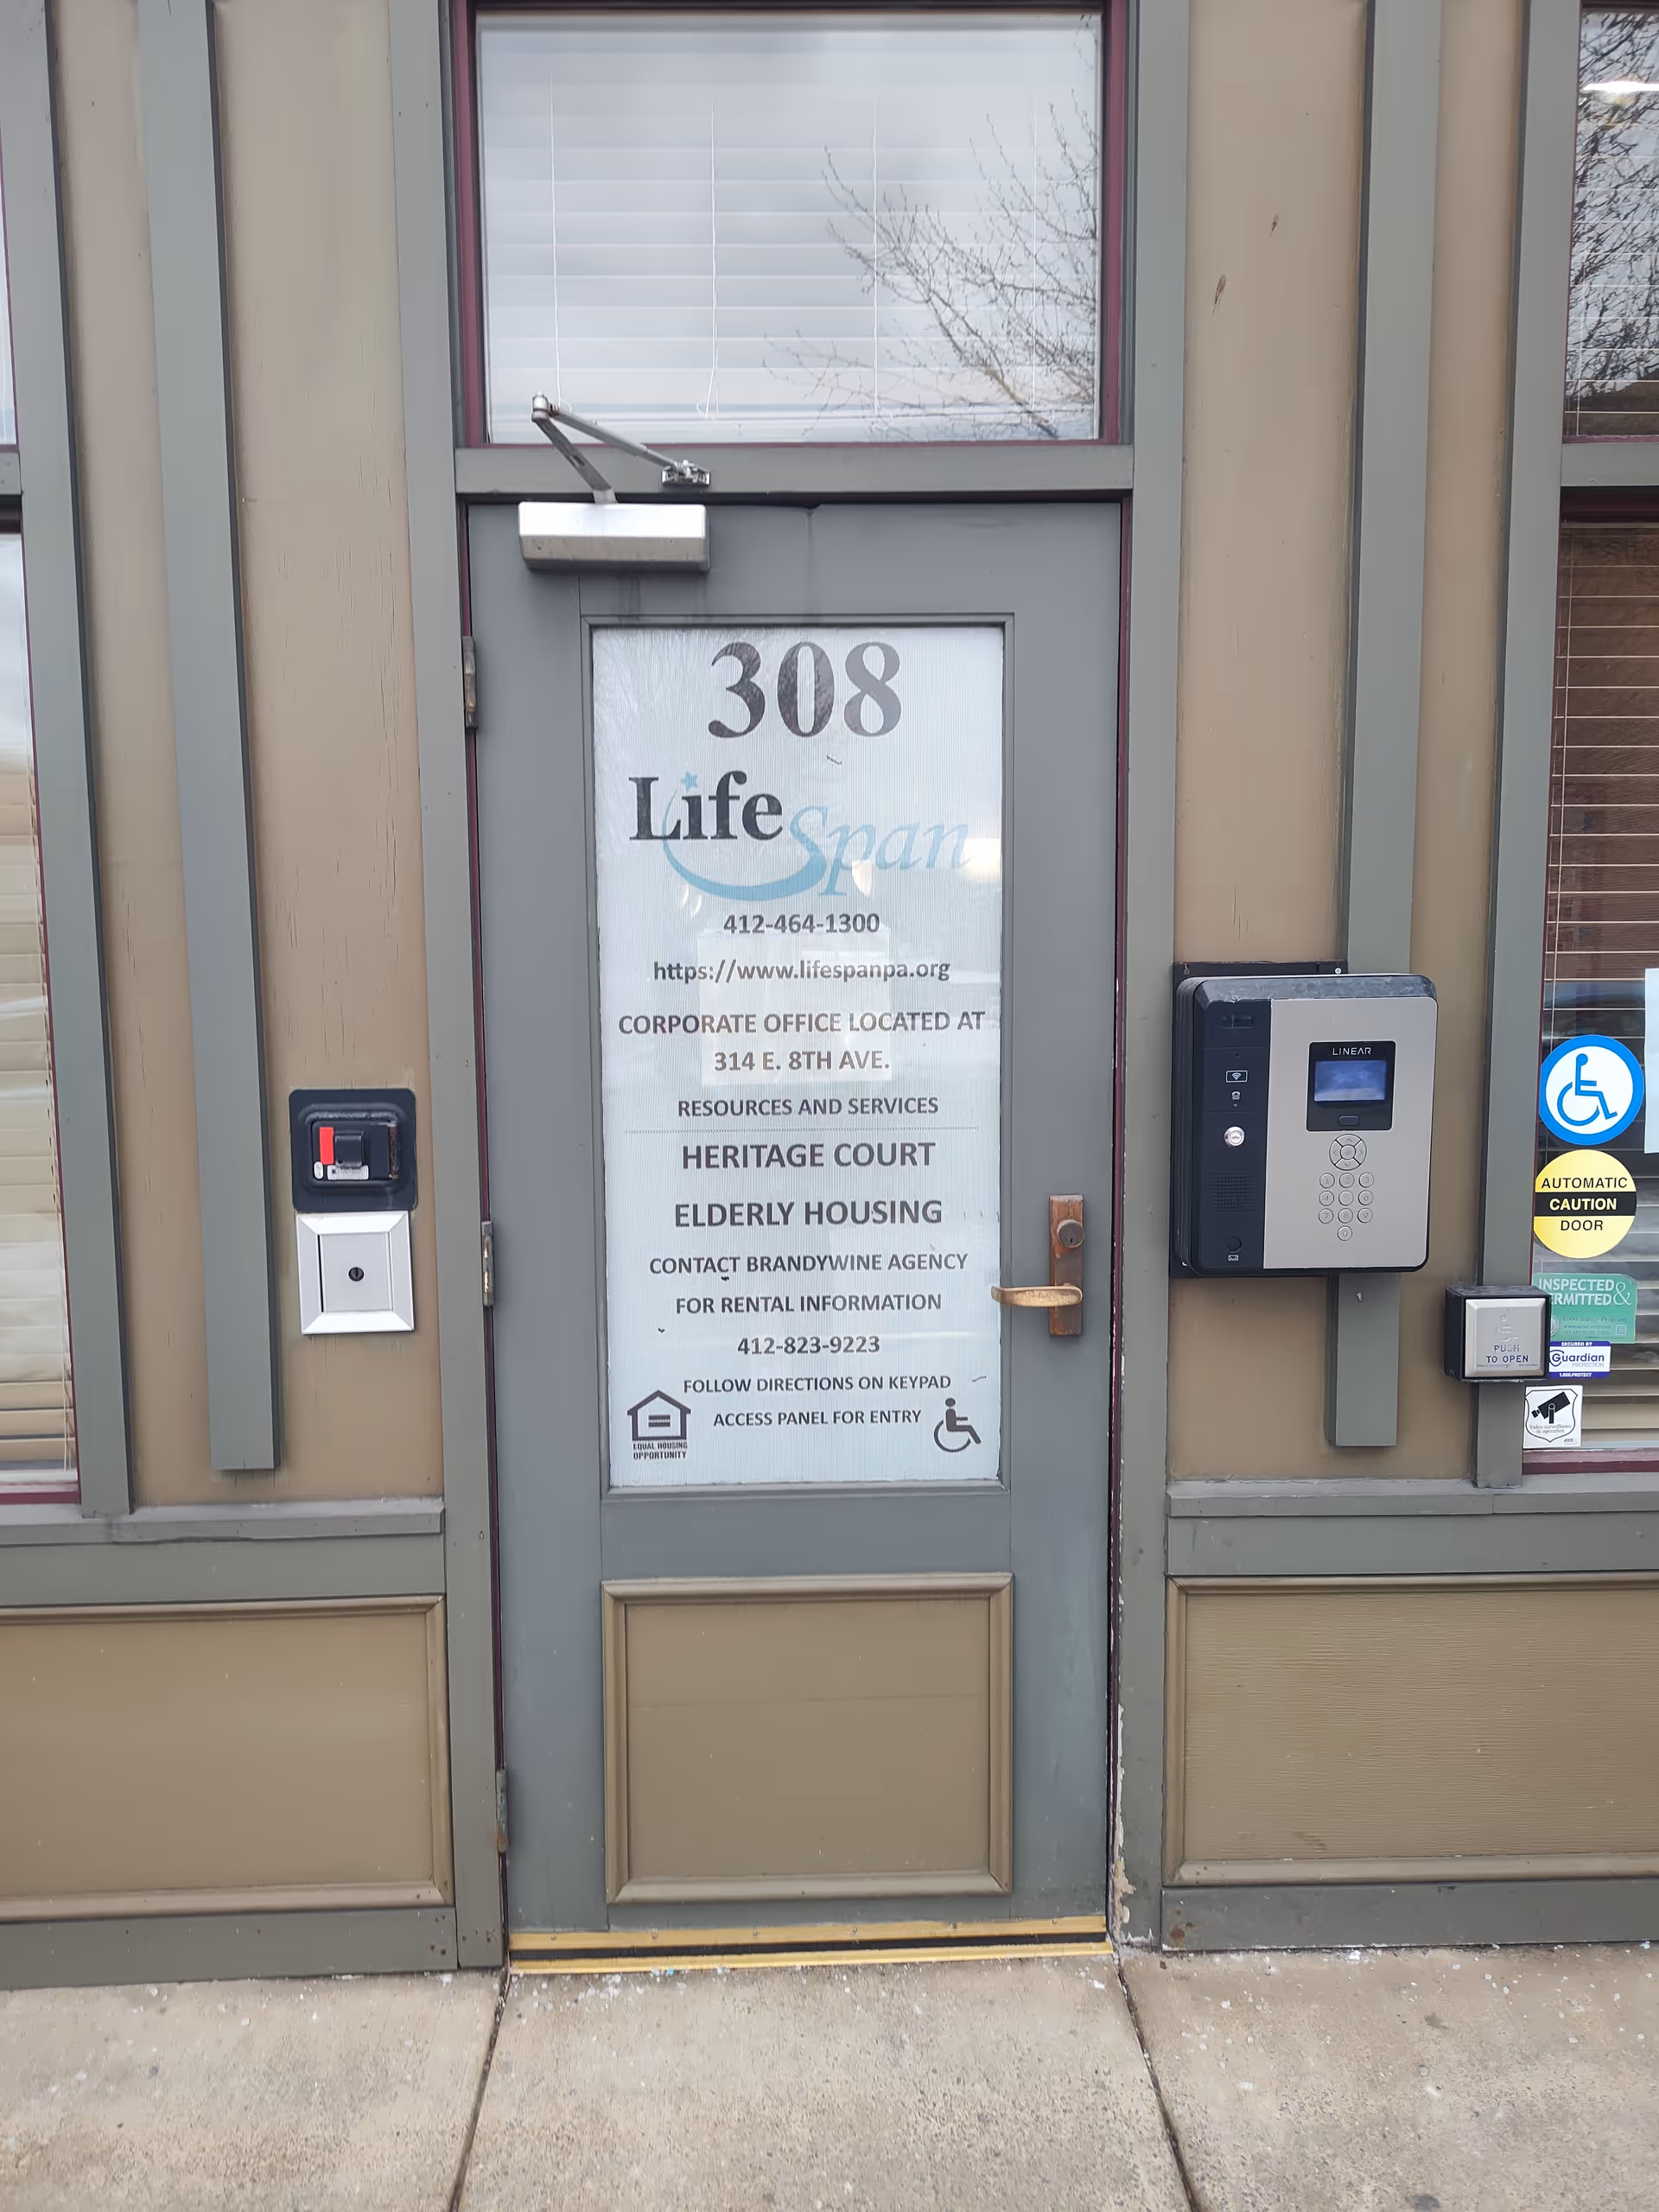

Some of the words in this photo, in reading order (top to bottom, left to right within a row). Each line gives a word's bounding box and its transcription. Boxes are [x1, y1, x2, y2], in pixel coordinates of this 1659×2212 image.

[708, 641, 902, 739] 308
[628, 770, 783, 842] Life
[787, 805, 972, 896] Span
[723, 913, 881, 935] 412-464-1300
[653, 959, 951, 986] https://www.lifespanpa.org
[619, 1014, 758, 1035] CORPORATE
[763, 1013, 842, 1034] OFFICE
[849, 1012, 951, 1033] LOCATED
[957, 1011, 987, 1032] AT
[715, 1052, 757, 1072] 314
[762, 1052, 782, 1071] E.
[788, 1051, 834, 1071] 8TH
[838, 1050, 891, 1071] AVE.
[1332, 1046, 1372, 1056] LINEAR
[677, 1099, 793, 1118] RESOURCES
[798, 1098, 843, 1116] AND
[848, 1097, 940, 1116] SERVICES
[683, 1143, 825, 1170] HERITAGE
[834, 1141, 938, 1167] COURT
[1541, 1177, 1628, 1189] AUTOMATIC
[675, 1203, 796, 1228] ELDERLY
[804, 1200, 943, 1226] HOUSING
[1549, 1198, 1618, 1211] CAUTION
[1560, 1219, 1604, 1231] DOOR
[649, 1256, 741, 1274] CONTACT
[747, 1254, 882, 1274] BRANDYWINE
[887, 1253, 969, 1271] AGENCY
[1538, 1278, 1615, 1292] INSPECTED
[676, 1297, 715, 1314] FOR
[721, 1296, 795, 1313] RENTAL
[800, 1294, 943, 1313] INFORMATION
[737, 1336, 880, 1356] 412-823-9223
[1485, 1355, 1498, 1363] TO
[1551, 1351, 1605, 1363] Guardian
[683, 1378, 753, 1394] FOLLOW
[756, 1376, 855, 1393] DIRECTIONS
[858, 1376, 884, 1391] ON
[888, 1376, 952, 1391] KEYPAD
[713, 1413, 773, 1427] ACCESS
[778, 1412, 830, 1427] PANEL
[833, 1411, 865, 1426] FOR
[870, 1410, 923, 1425] ENTRY
[632, 1442, 655, 1451] EQUAL
[657, 1441, 688, 1450] HOUSING
[632, 1451, 687, 1460] OPPORTUNITY
